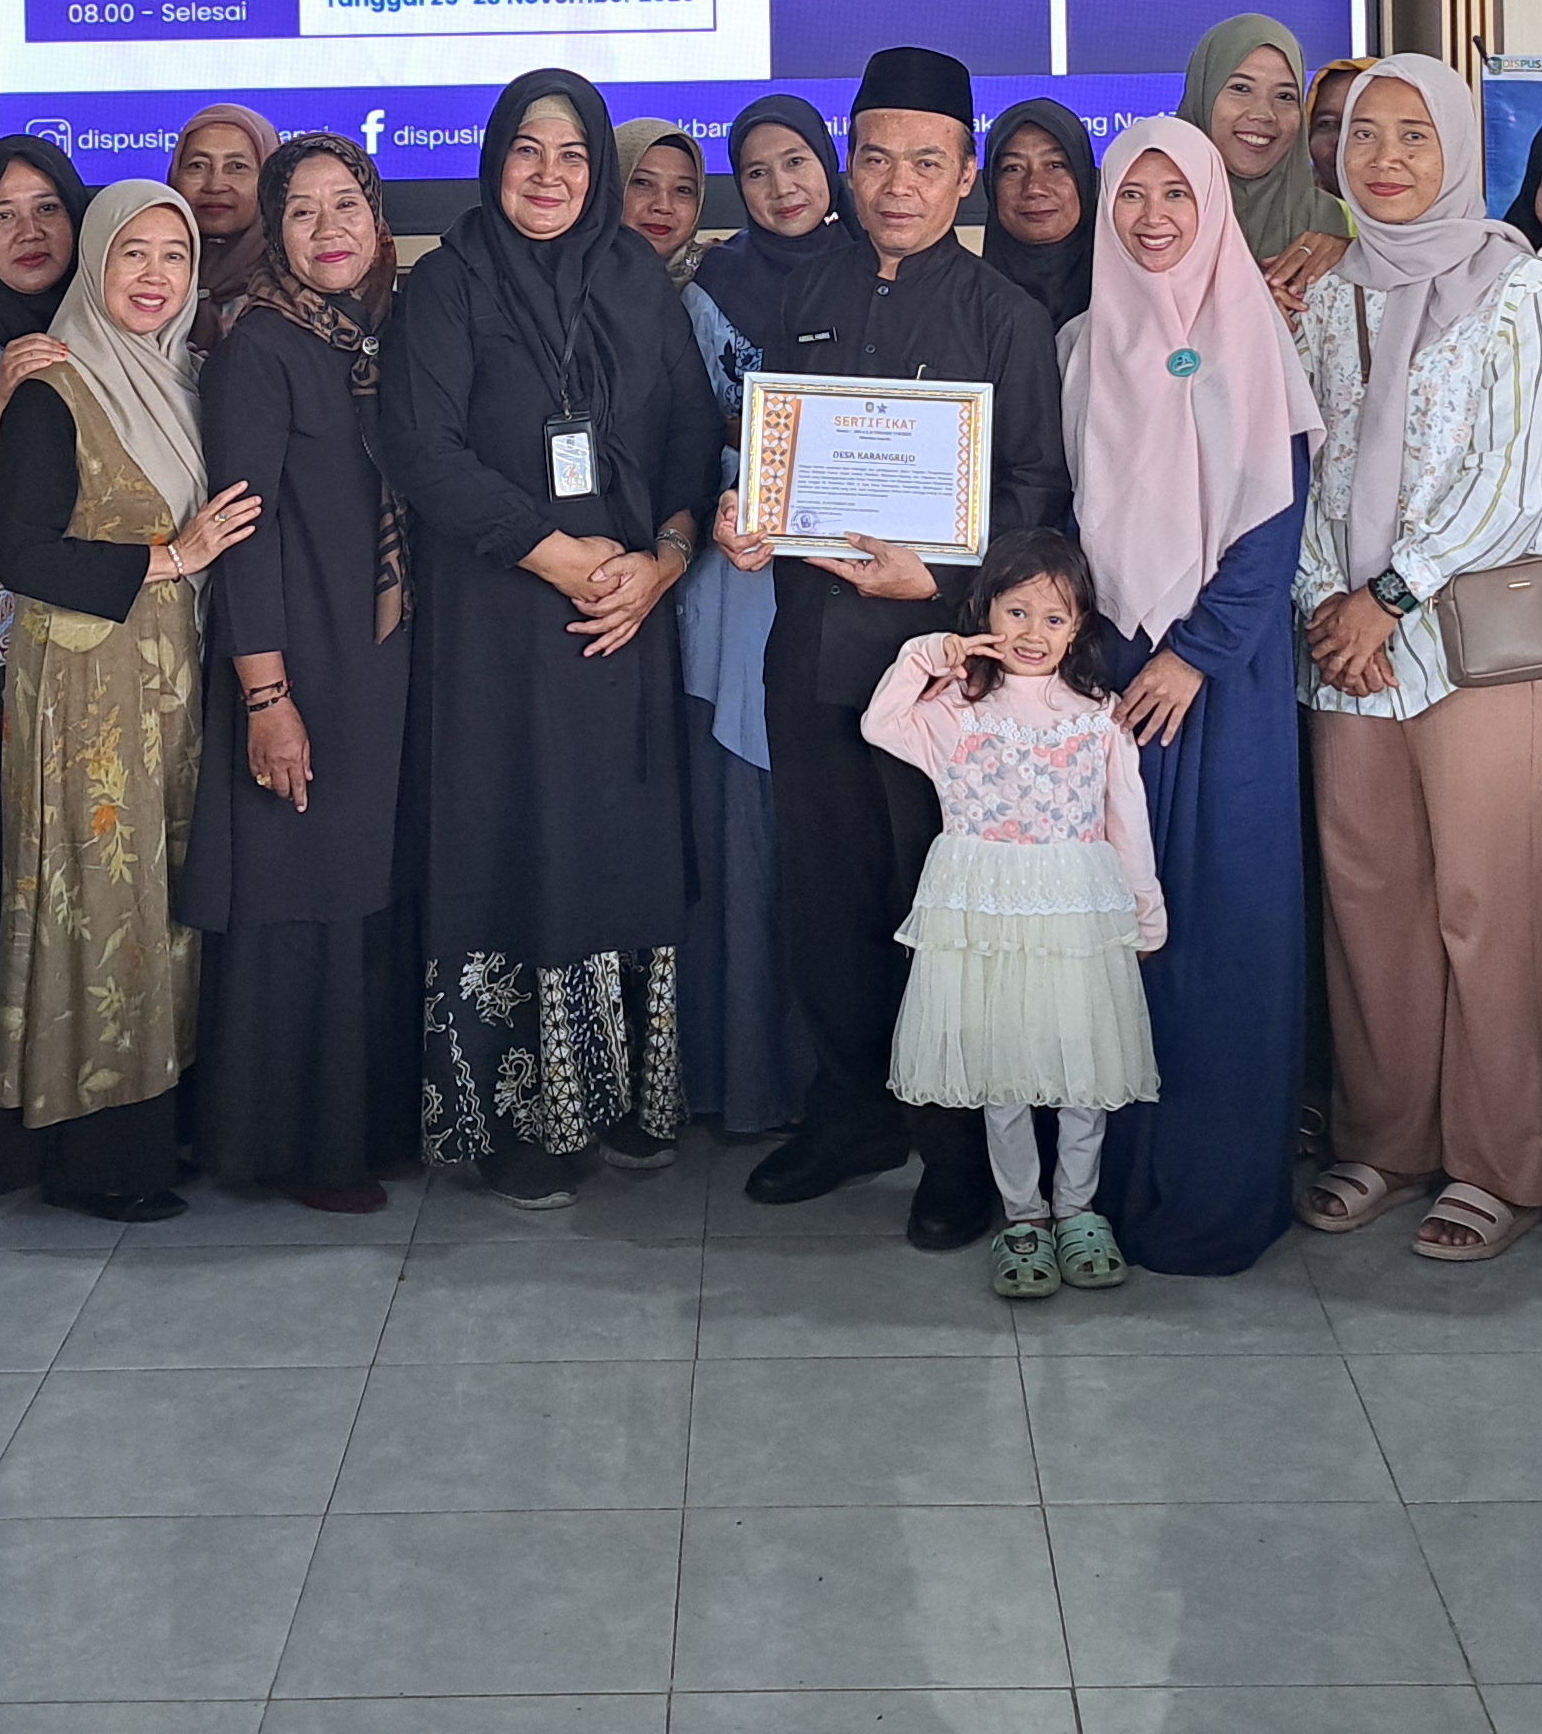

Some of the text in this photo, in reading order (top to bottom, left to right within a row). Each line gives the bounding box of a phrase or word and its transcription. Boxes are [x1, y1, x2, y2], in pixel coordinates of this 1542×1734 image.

[67, 2, 135, 25] 08.00
[160, 1, 247, 23] Selesai
[834, 416, 916, 430] SERTIFIKAT
[833, 451, 915, 463] DESA KARANGREJO
